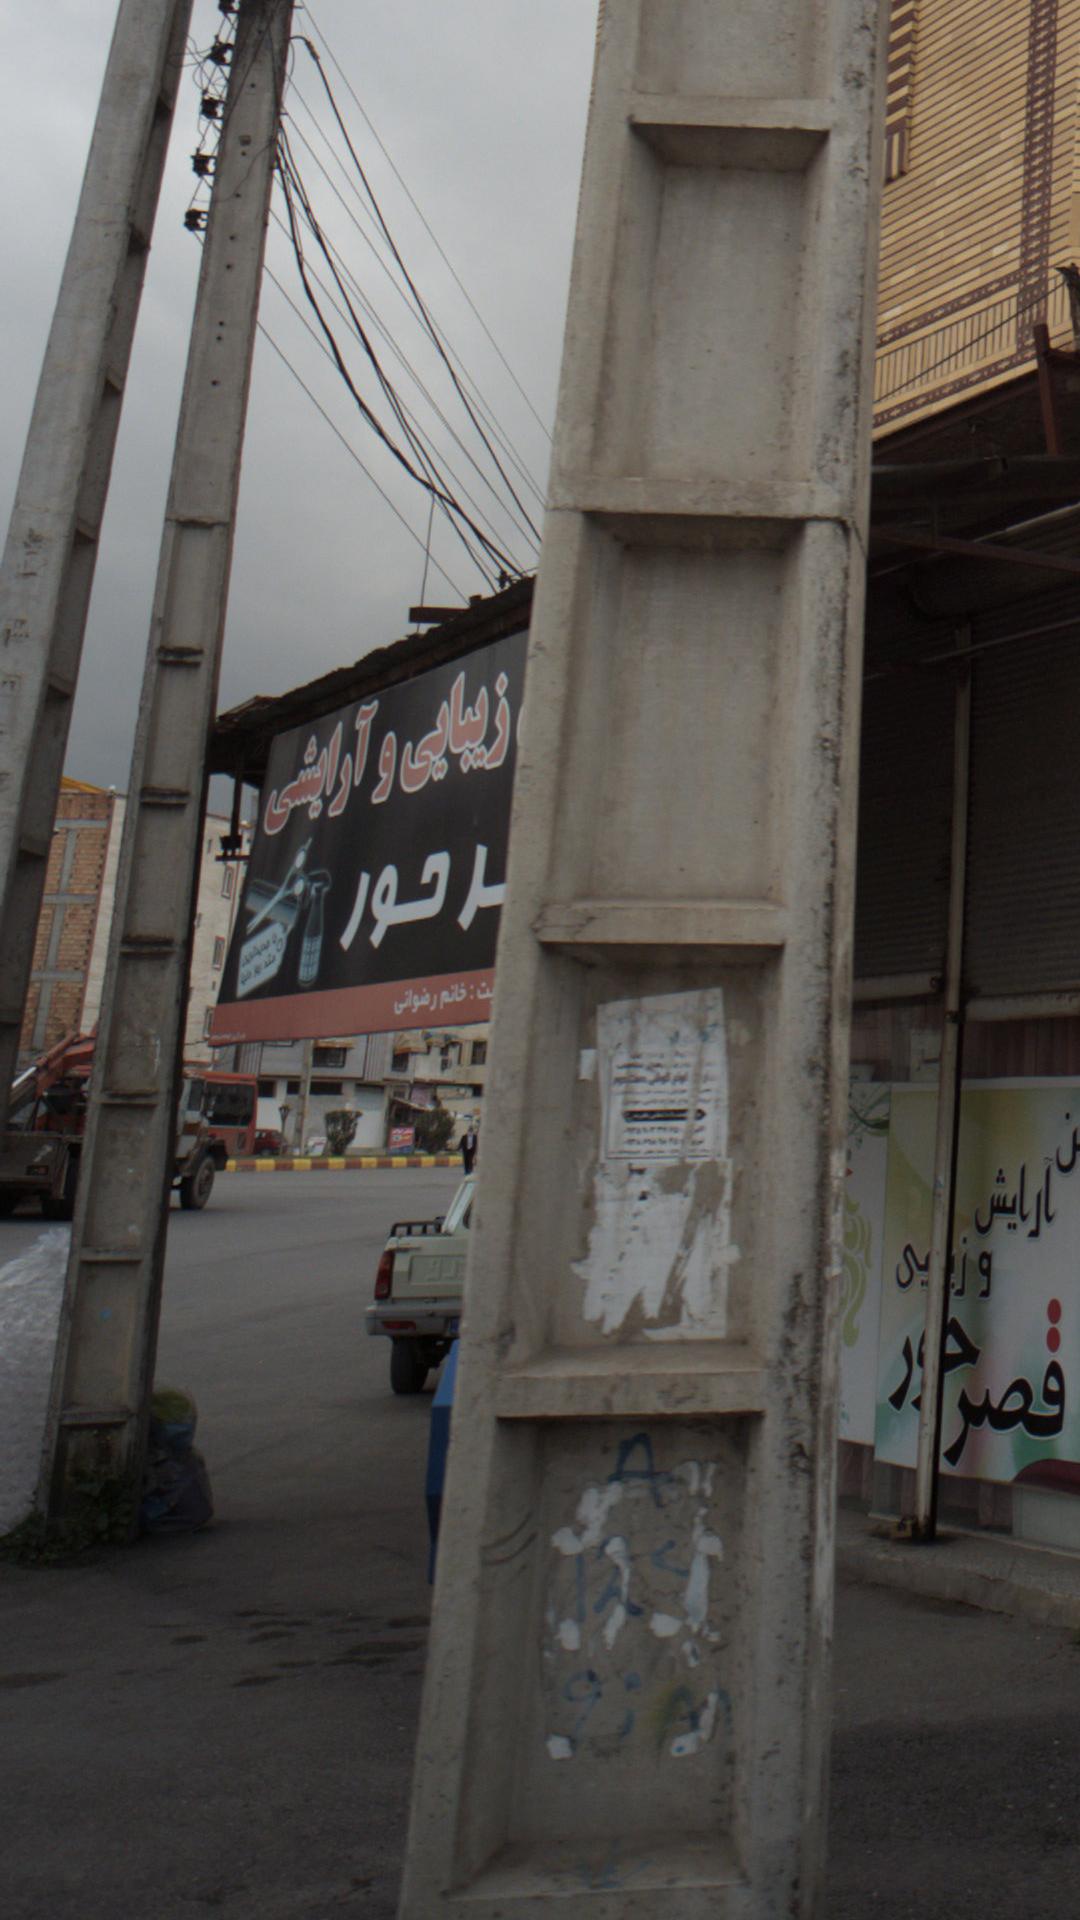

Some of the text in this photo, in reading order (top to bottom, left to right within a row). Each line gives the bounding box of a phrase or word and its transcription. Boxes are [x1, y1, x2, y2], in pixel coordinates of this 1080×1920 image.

[264, 671, 511, 835] زیبایی و آرایشی
[340, 851, 451, 951] حور
[393, 987, 438, 1015] رضوانی
[439, 982, 467, 1010] خانم
[975, 1157, 1056, 1238] آرایش
[978, 1249, 993, 1298] و
[943, 1298, 1066, 1466] قصر
